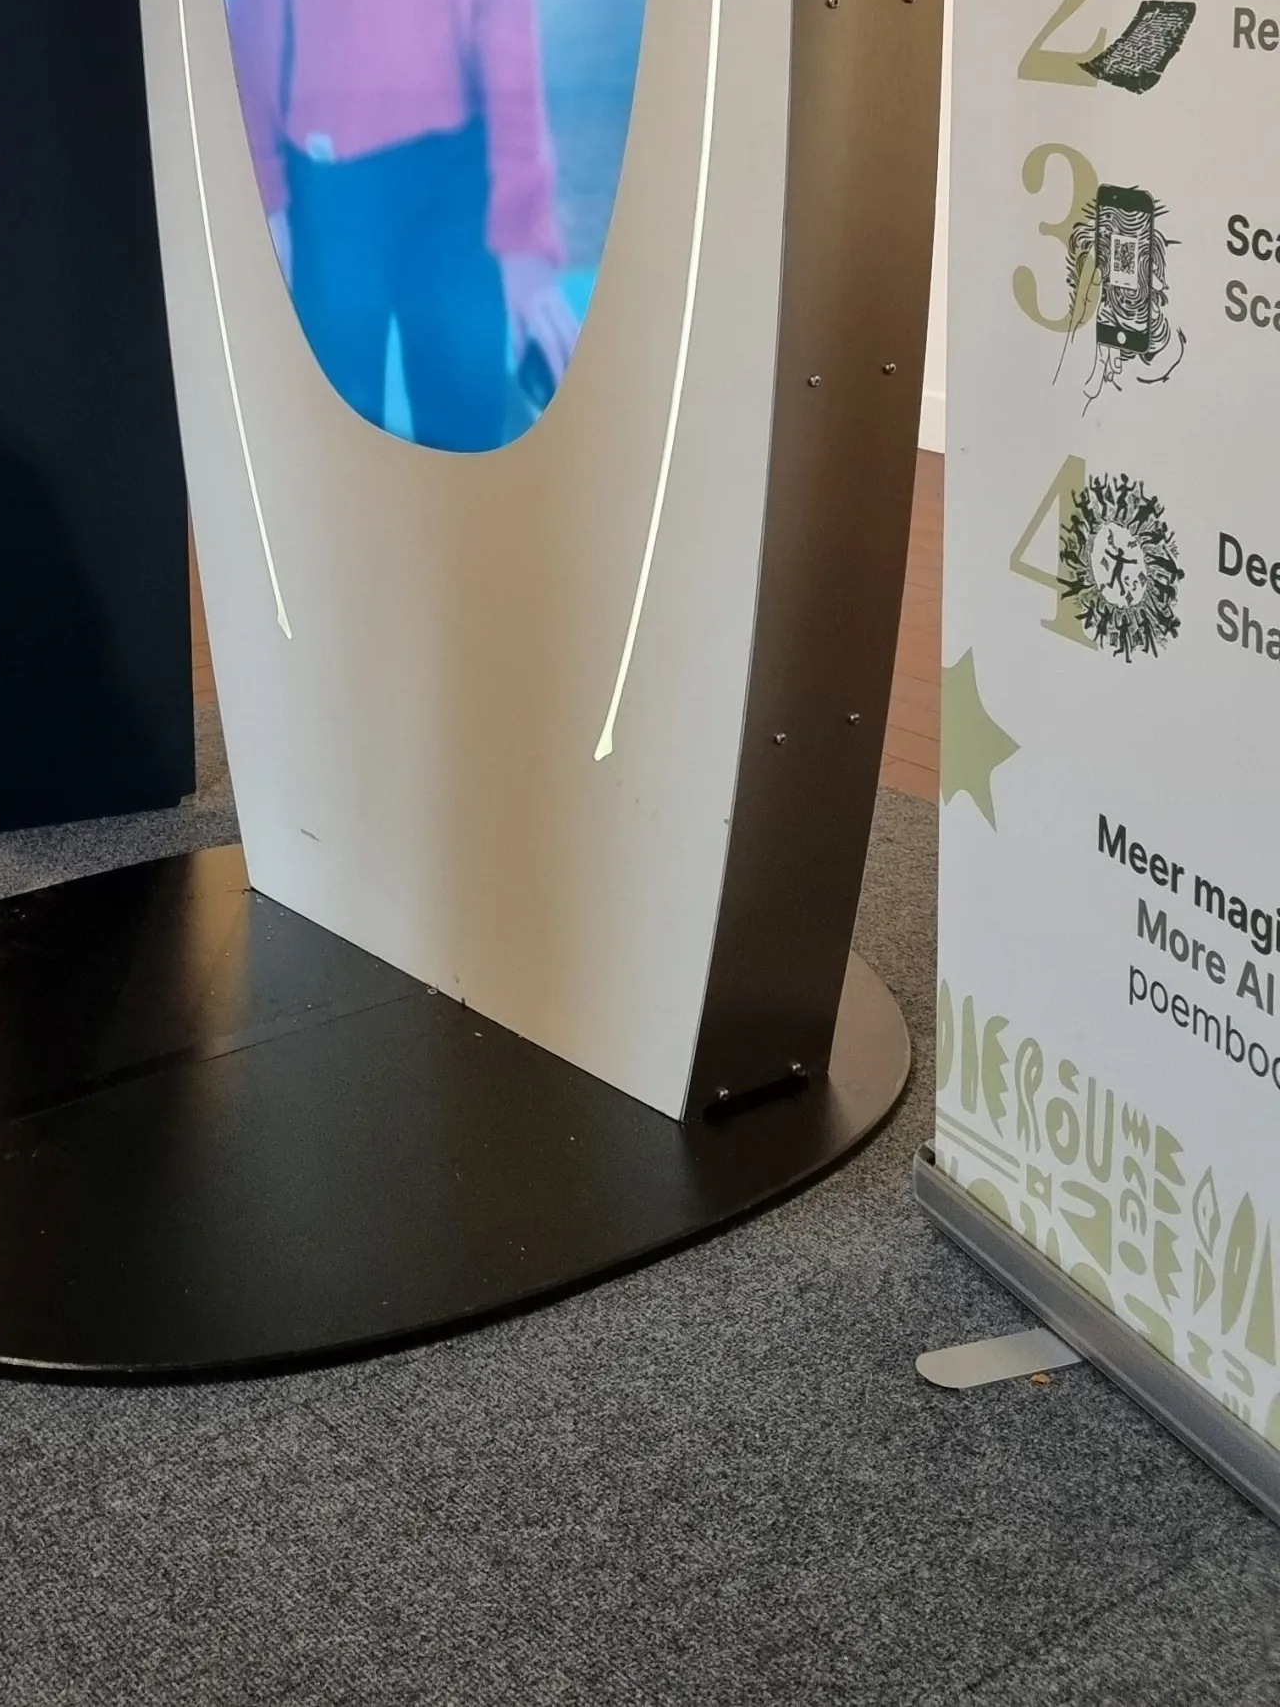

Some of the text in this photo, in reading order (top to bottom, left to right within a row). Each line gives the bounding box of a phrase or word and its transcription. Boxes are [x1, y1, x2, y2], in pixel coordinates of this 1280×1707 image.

[1012, 143, 1102, 333] 3
[1227, 214, 1280, 264] Sc
[1009, 454, 1098, 651] 4
[1098, 813, 1185, 894] Meer
[1137, 897, 1274, 1016] More AI
